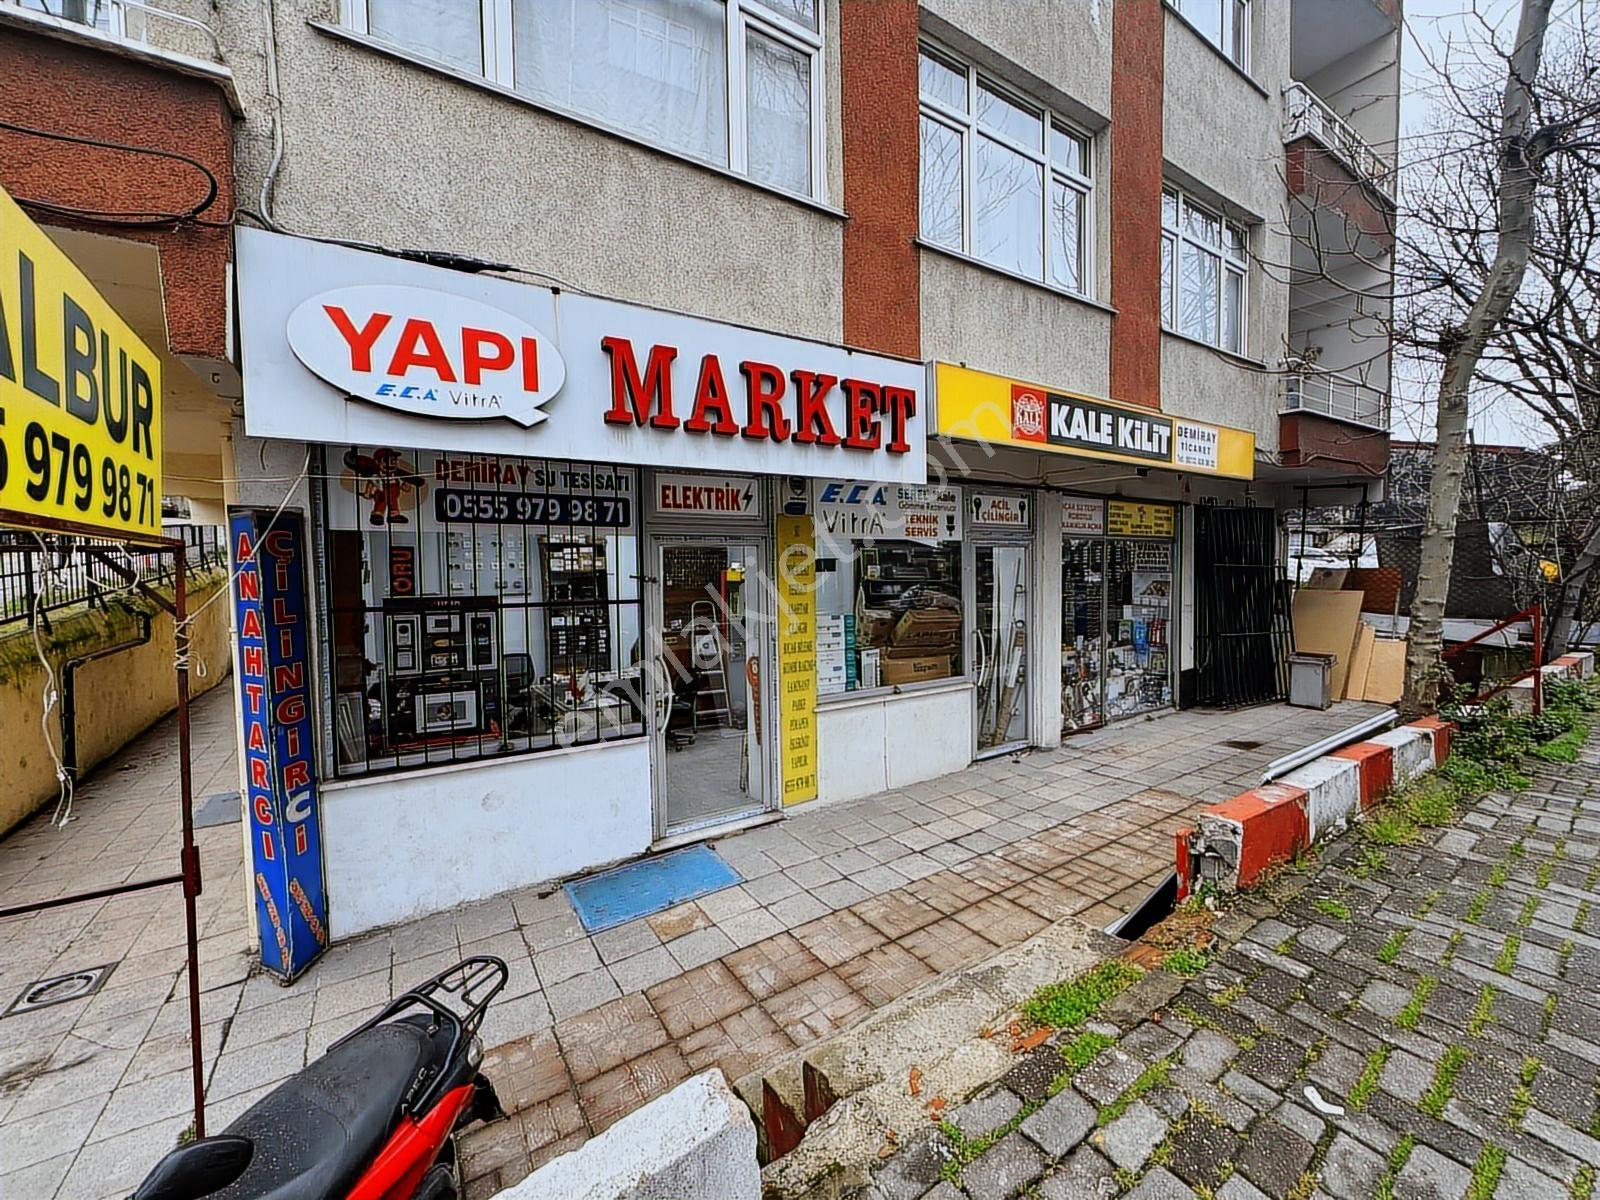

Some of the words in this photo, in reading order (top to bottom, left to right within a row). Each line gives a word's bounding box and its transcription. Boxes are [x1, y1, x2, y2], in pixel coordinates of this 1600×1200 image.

[322, 304, 540, 392] YAPI
[449, 389, 501, 409] VitrA
[601, 335, 917, 454] MARKET
[1051, 402, 1113, 445] KALE
[24, 421, 94, 512] 979
[101, 456, 132, 522] 98
[136, 472, 155, 528] 71
[534, 468, 556, 487] SU
[445, 493, 509, 521] 0555
[516, 498, 561, 521] 979
[570, 499, 597, 522] 98
[603, 501, 625, 524] 71
[661, 481, 741, 511] ELEKTRİK
[990, 498, 1011, 511] ACİL
[822, 509, 884, 535] VitrA
[905, 512, 939, 525] TEKNİK
[905, 524, 938, 537] SERVİS
[236, 532, 276, 861] ANAHTARCI
